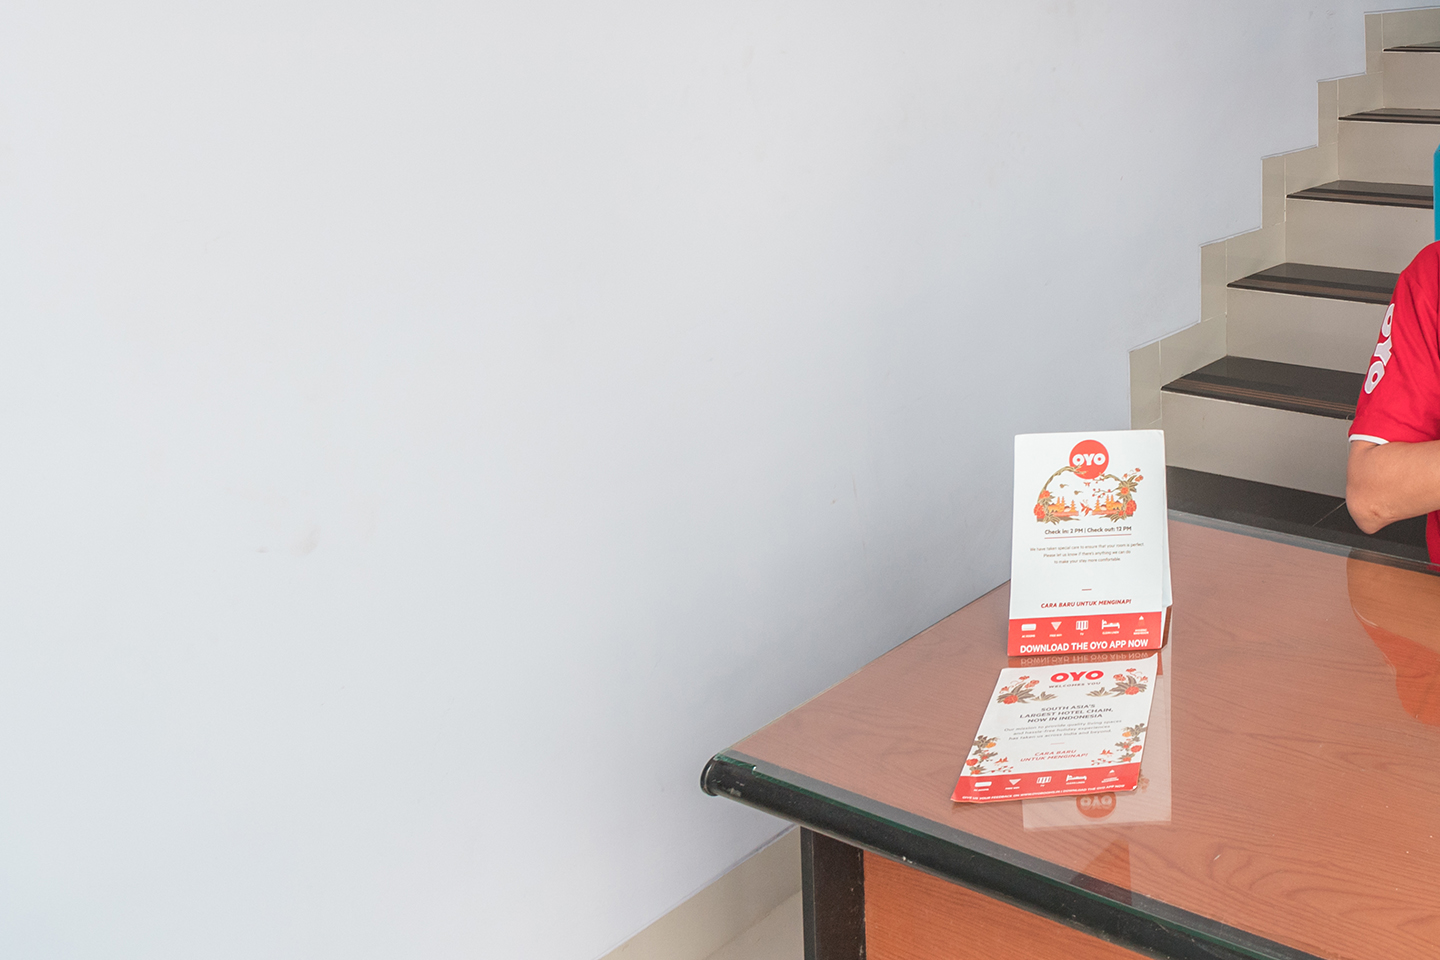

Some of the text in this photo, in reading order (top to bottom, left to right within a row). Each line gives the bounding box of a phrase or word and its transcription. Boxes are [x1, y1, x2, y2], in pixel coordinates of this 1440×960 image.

[1364, 303, 1395, 394] OYO
[1072, 453, 1106, 466] OYO
[1020, 639, 1149, 654] DOWNLOAD THE OYO APP NOW
[1050, 670, 1104, 683] OYO
[1059, 713, 1103, 721] INDONESIA
